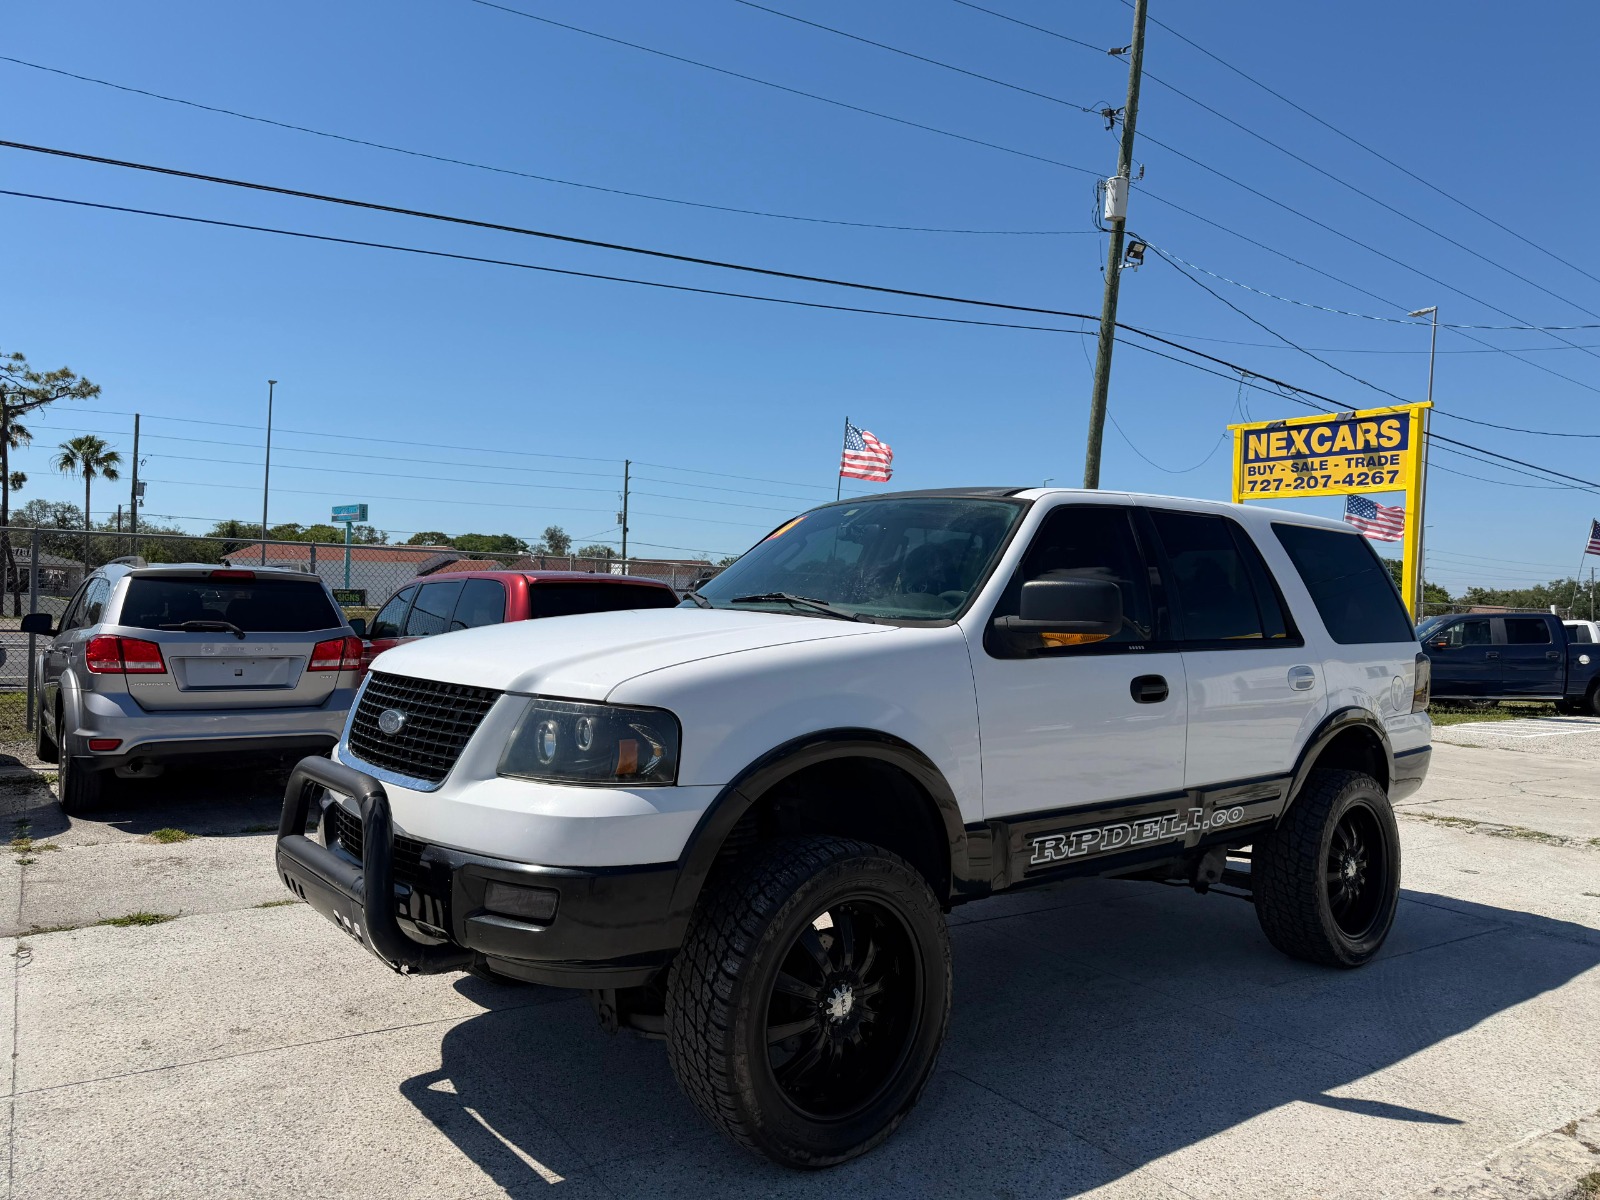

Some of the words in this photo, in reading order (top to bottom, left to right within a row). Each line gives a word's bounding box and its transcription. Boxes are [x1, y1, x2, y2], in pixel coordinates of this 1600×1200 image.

[1247, 419, 1402, 460] NEXCARS
[1247, 464, 1277, 477] BUY
[1290, 460, 1329, 473] SALE
[1345, 454, 1400, 469] TRADE
[1247, 470, 1400, 492] 727-207-4267
[337, 593, 360, 602] SIGNS
